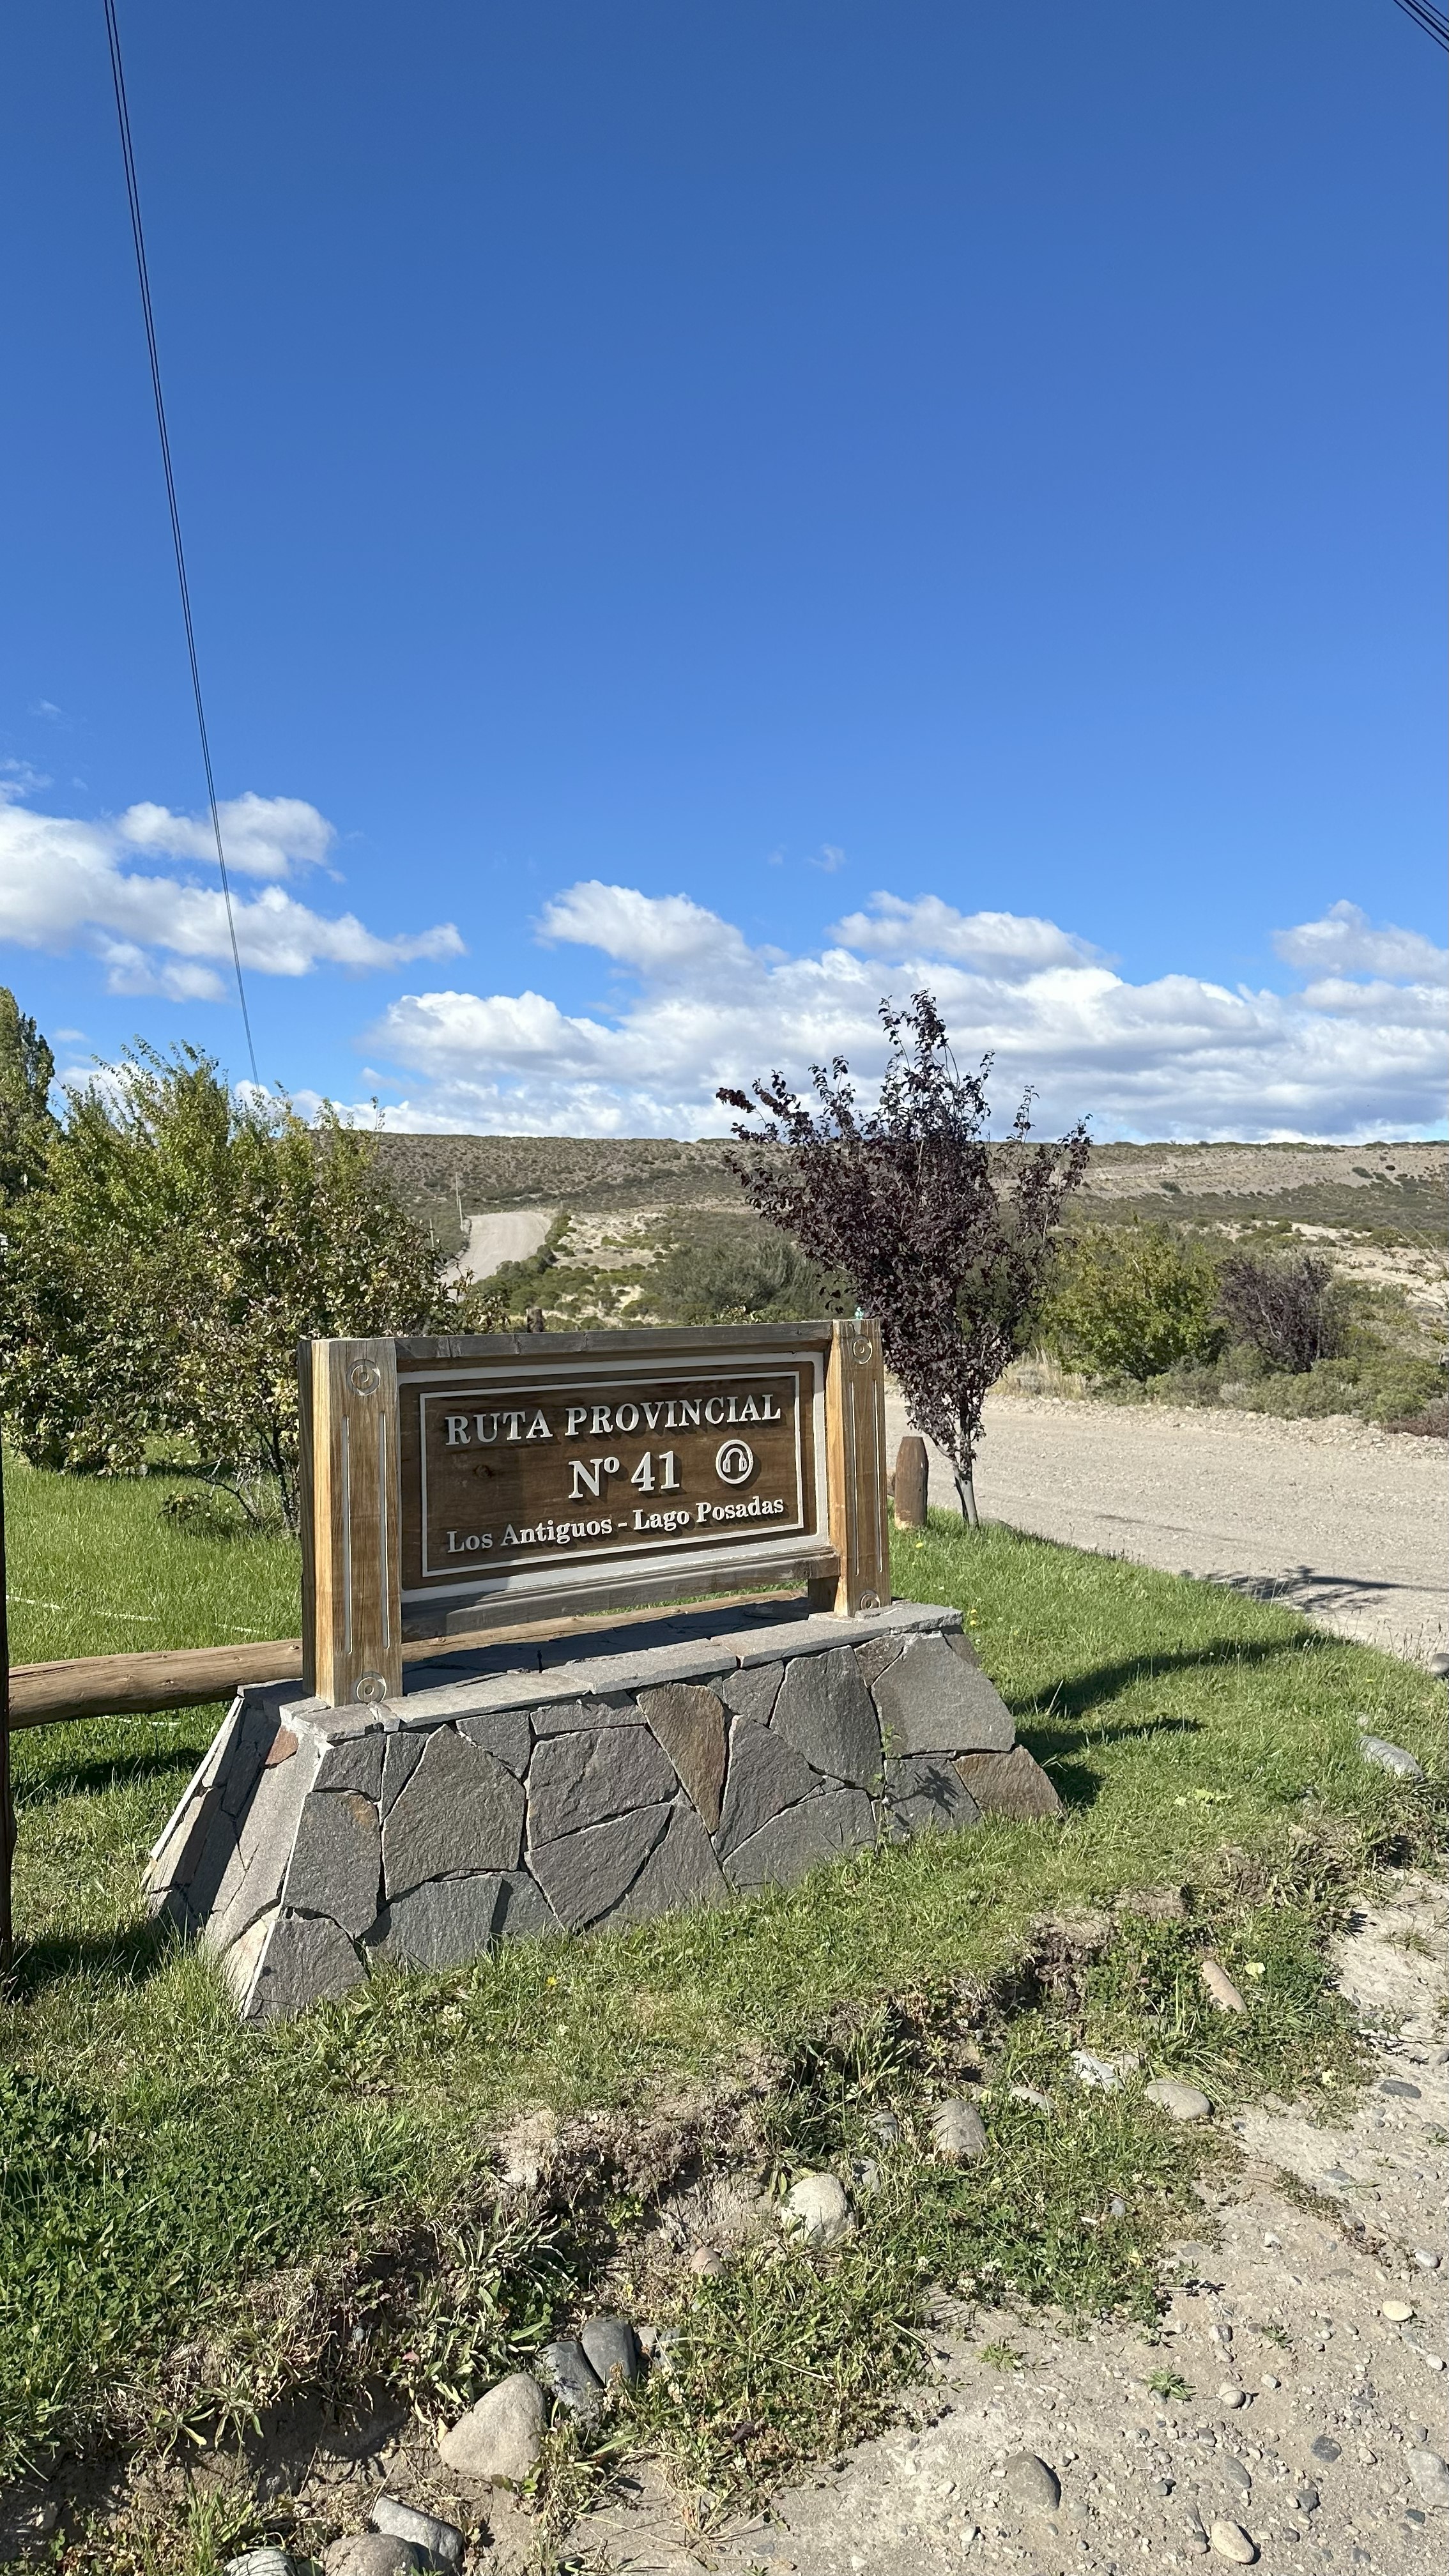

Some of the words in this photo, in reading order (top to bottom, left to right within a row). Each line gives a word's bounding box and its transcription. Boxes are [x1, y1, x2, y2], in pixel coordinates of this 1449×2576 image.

[445, 1409, 553, 1445] RUTA
[565, 1394, 781, 1436] PROVINCIAL
[631, 1450, 680, 1492] 41
[447, 1530, 493, 1553] Los
[500, 1519, 613, 1546] Antiguos
[632, 1510, 689, 1531] Lago
[696, 1496, 783, 1523] Posadas
